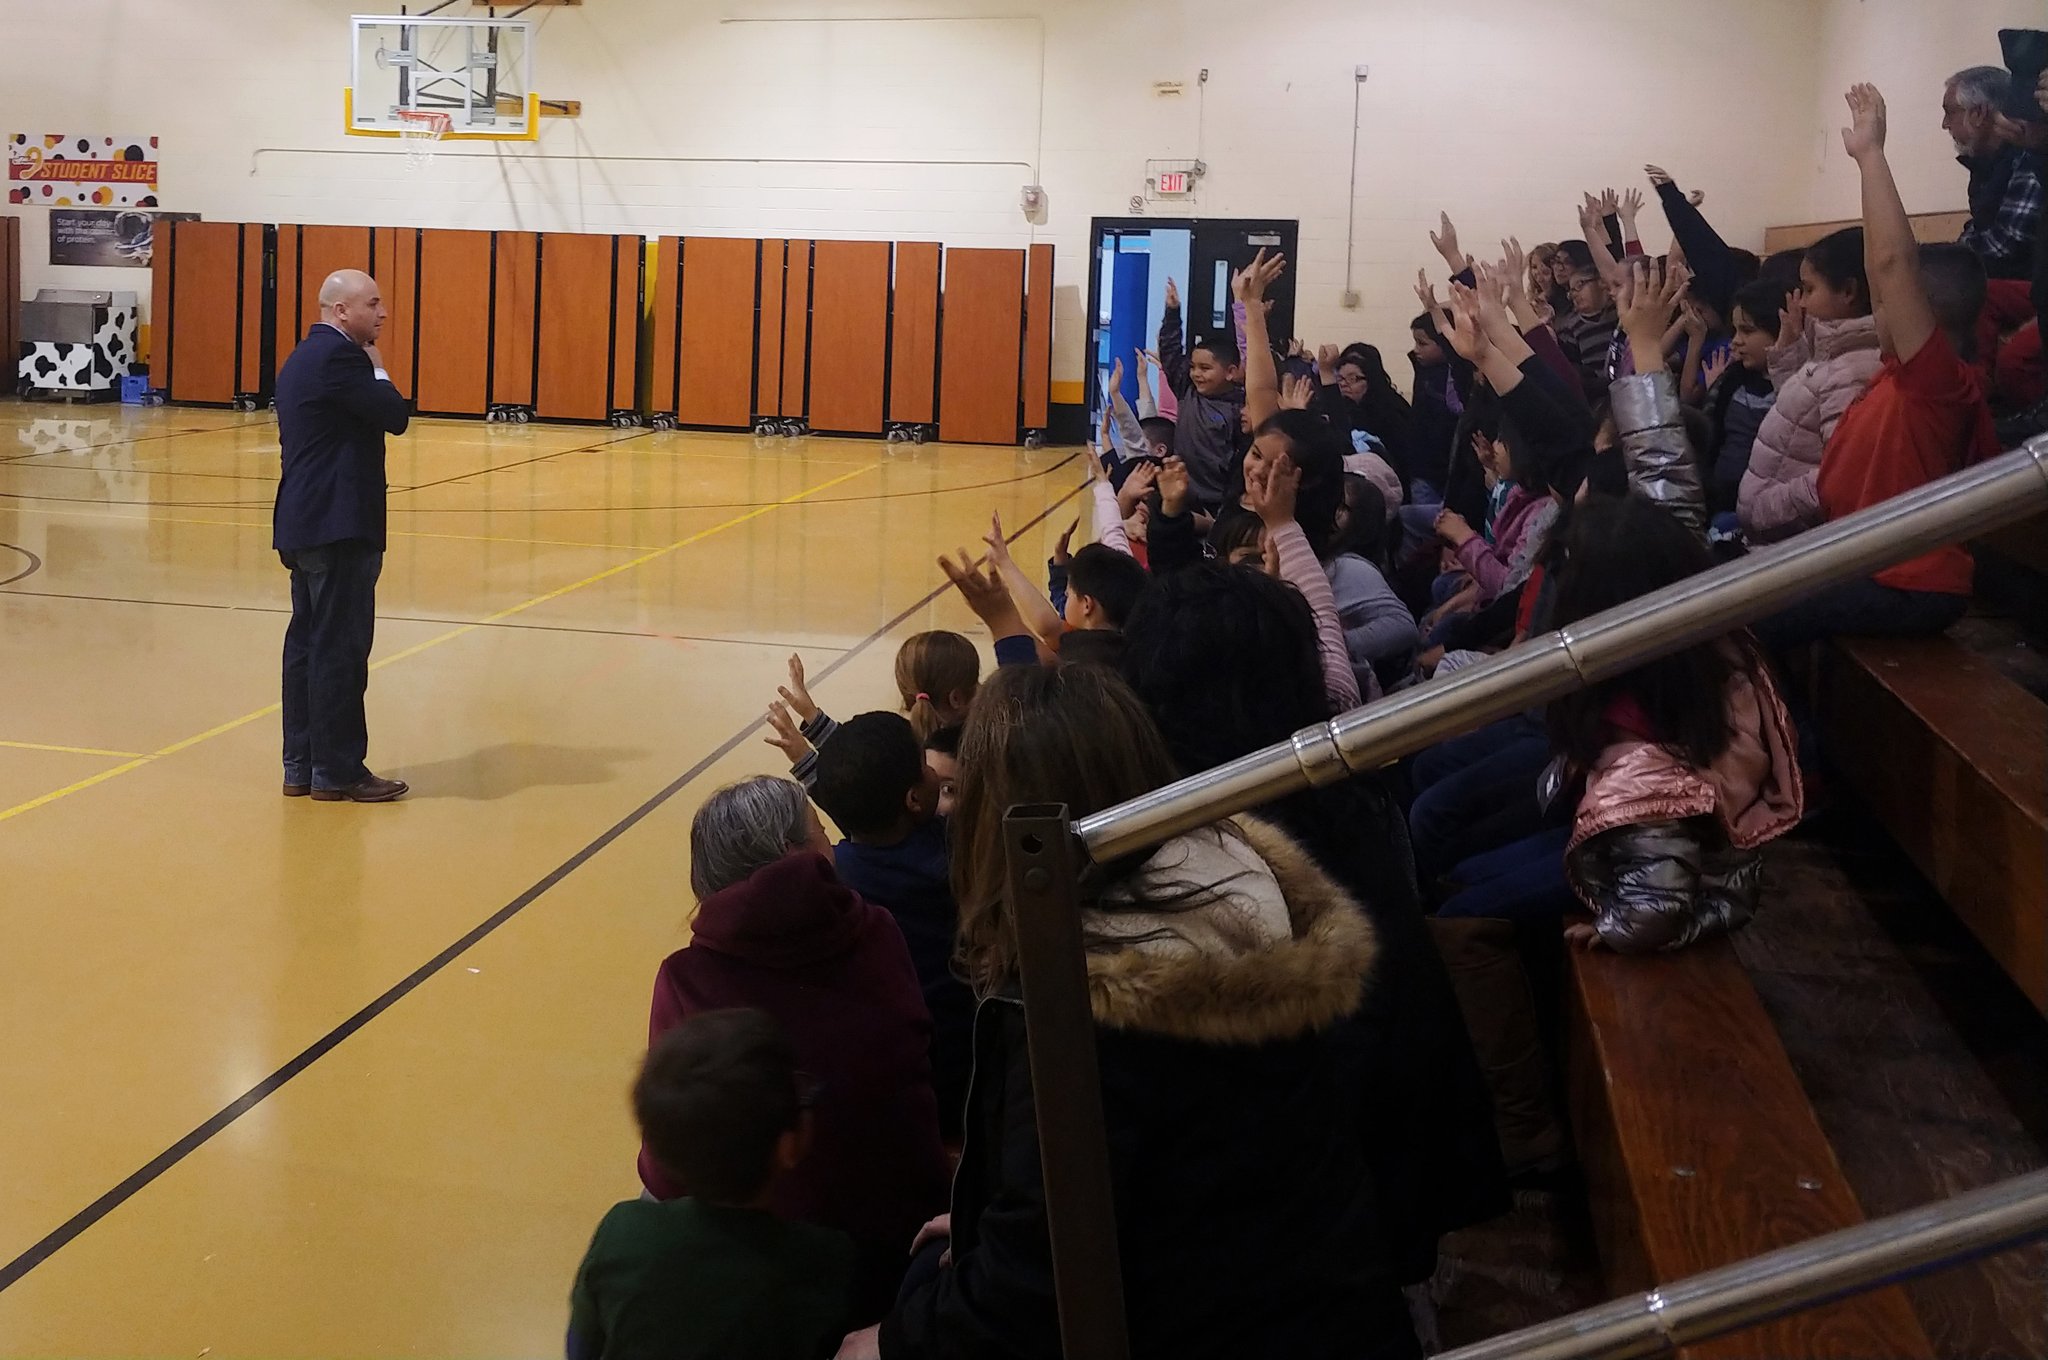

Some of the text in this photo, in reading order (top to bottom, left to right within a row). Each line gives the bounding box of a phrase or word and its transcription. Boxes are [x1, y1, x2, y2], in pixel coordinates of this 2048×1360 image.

[40, 161, 157, 180] STUDENT SLICE
[1161, 174, 1183, 191] EXIT
